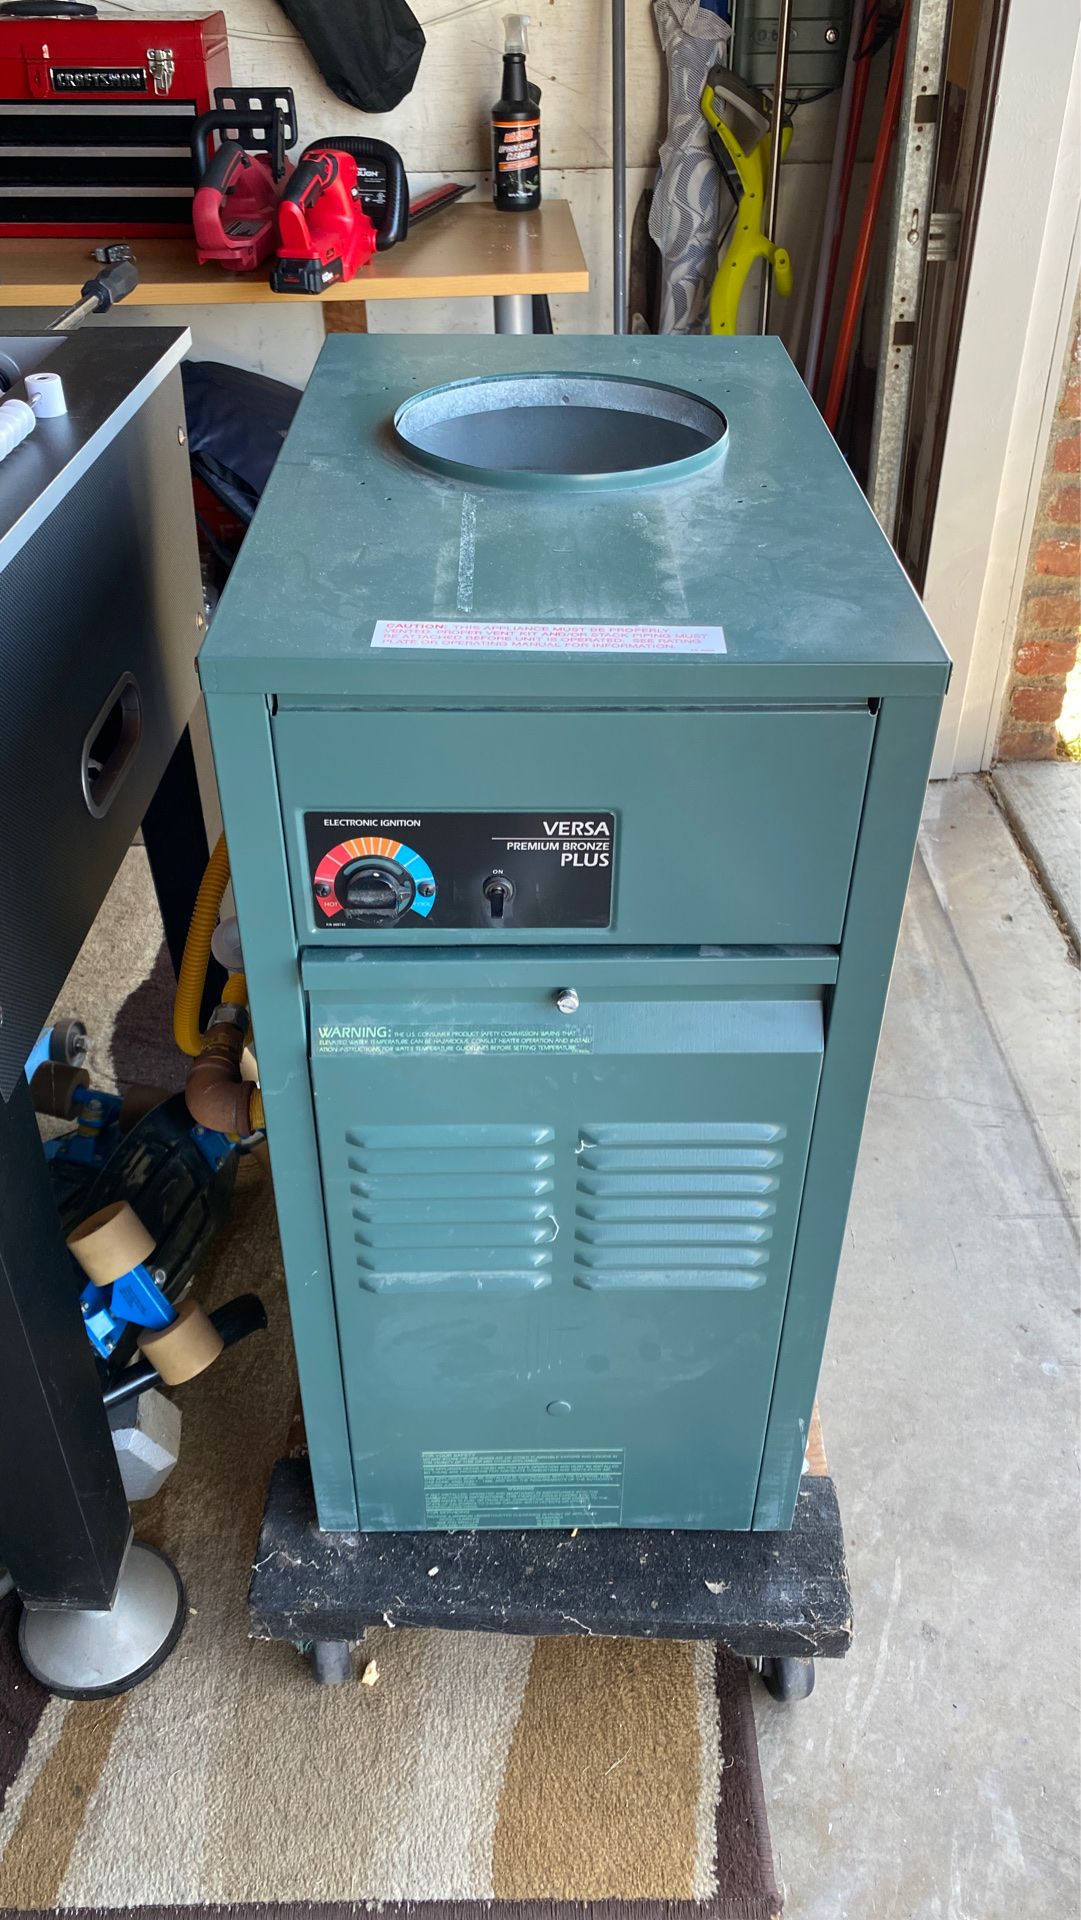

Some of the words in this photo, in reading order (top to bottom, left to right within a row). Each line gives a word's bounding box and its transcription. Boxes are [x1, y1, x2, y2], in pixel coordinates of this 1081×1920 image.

[57, 73, 140, 87] CRAFTSMAN
[498, 139, 537, 154] UPHOLSTERY
[505, 149, 531, 161] CLEANER
[323, 819, 378, 827] ELECTRONIC
[380, 819, 421, 827] IGNITION
[543, 821, 610, 836] VERSA
[506, 842, 561, 851] PREMIUM
[562, 842, 610, 851] BRONZE
[560, 853, 609, 867] PLUS
[318, 1026, 391, 1038] WARNING:
